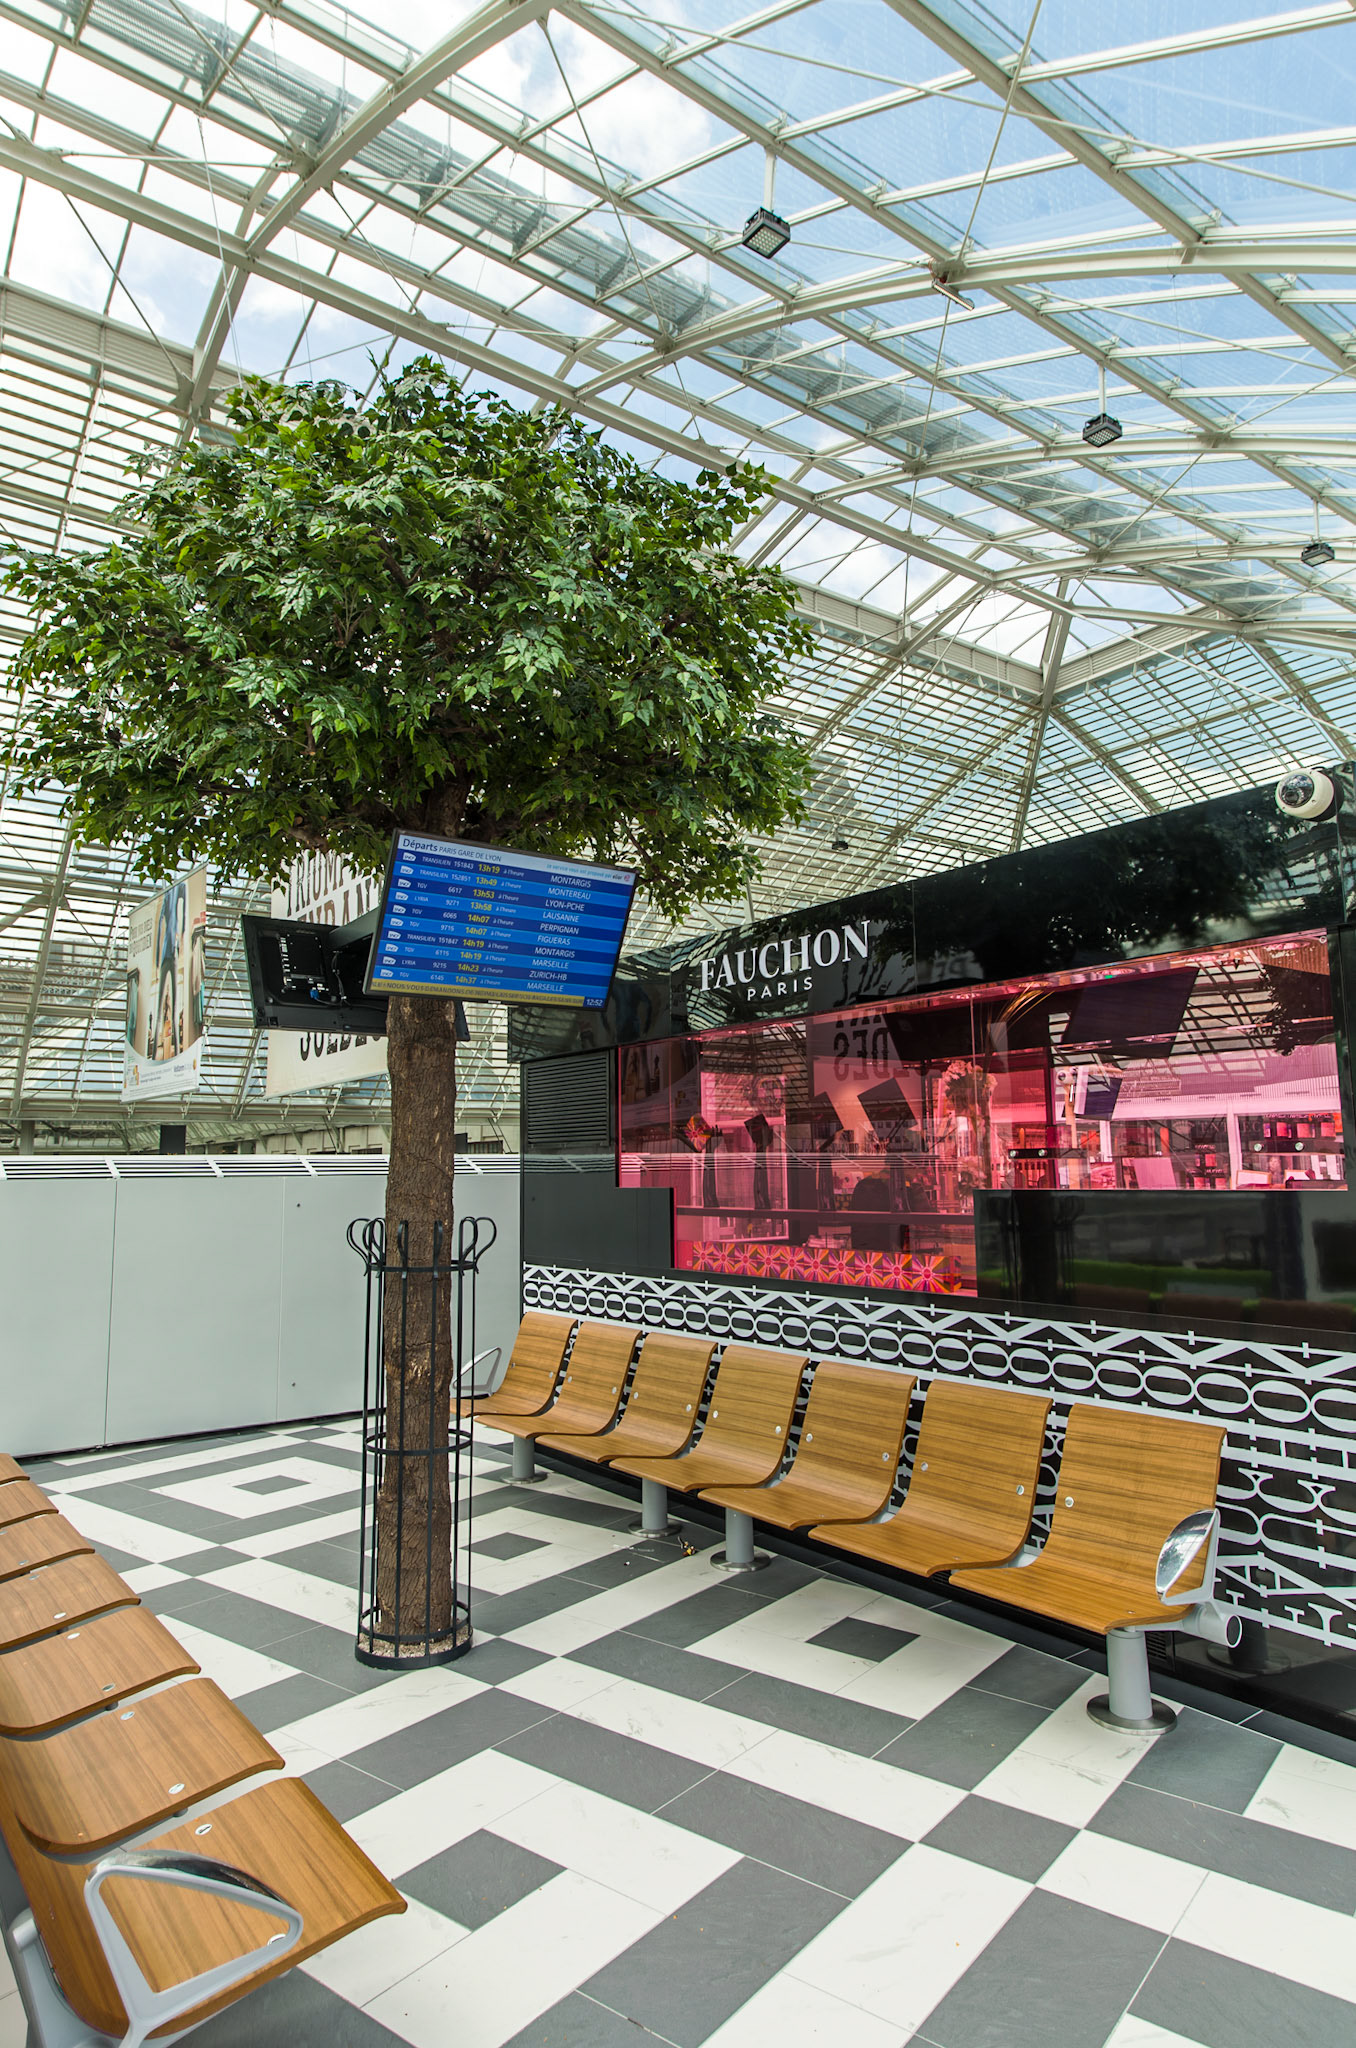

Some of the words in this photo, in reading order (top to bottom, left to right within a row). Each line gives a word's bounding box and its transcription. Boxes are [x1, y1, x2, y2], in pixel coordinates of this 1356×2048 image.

[402, 839, 438, 852] Départs
[438, 846, 456, 854] PARIS
[457, 849, 474, 857] GARE
[421, 856, 450, 865] TRANSILIEN
[452, 860, 474, 869] 151843
[477, 863, 500, 874] 13h19
[506, 869, 524, 877] l'heure
[550, 875, 591, 887] MONTARGIS
[419, 869, 448, 878] TRANSILIEN
[474, 876, 497, 886] 13h49
[547, 887, 591, 900] MONTEREAU
[447, 886, 462, 894] 6617
[472, 889, 495, 899] 13h53
[544, 899, 585, 911] LYON-PCHE
[469, 901, 492, 911] 13h58
[499, 906, 516, 914] l'heure
[542, 911, 579, 922] LAUSANNE
[467, 914, 490, 923] 14h07
[539, 923, 579, 934] PERPIGNAN
[406, 933, 435, 941] TRANSILIEN
[462, 938, 485, 948] 14h19
[534, 947, 575, 958] MONTARGIS
[464, 926, 487, 936] 14h07
[536, 935, 570, 945] FIGUERAS
[459, 951, 482, 960] 14h19
[531, 959, 569, 969] MARSEILLE
[700, 920, 870, 992] FAUCHON
[456, 963, 480, 972] 14h23
[528, 971, 567, 981] ZURICH-HB
[454, 976, 477, 984] 14h37
[526, 983, 564, 992] MARSEILLE
[748, 977, 813, 1001] PARIS
[585, 998, 603, 1006] 12:52
